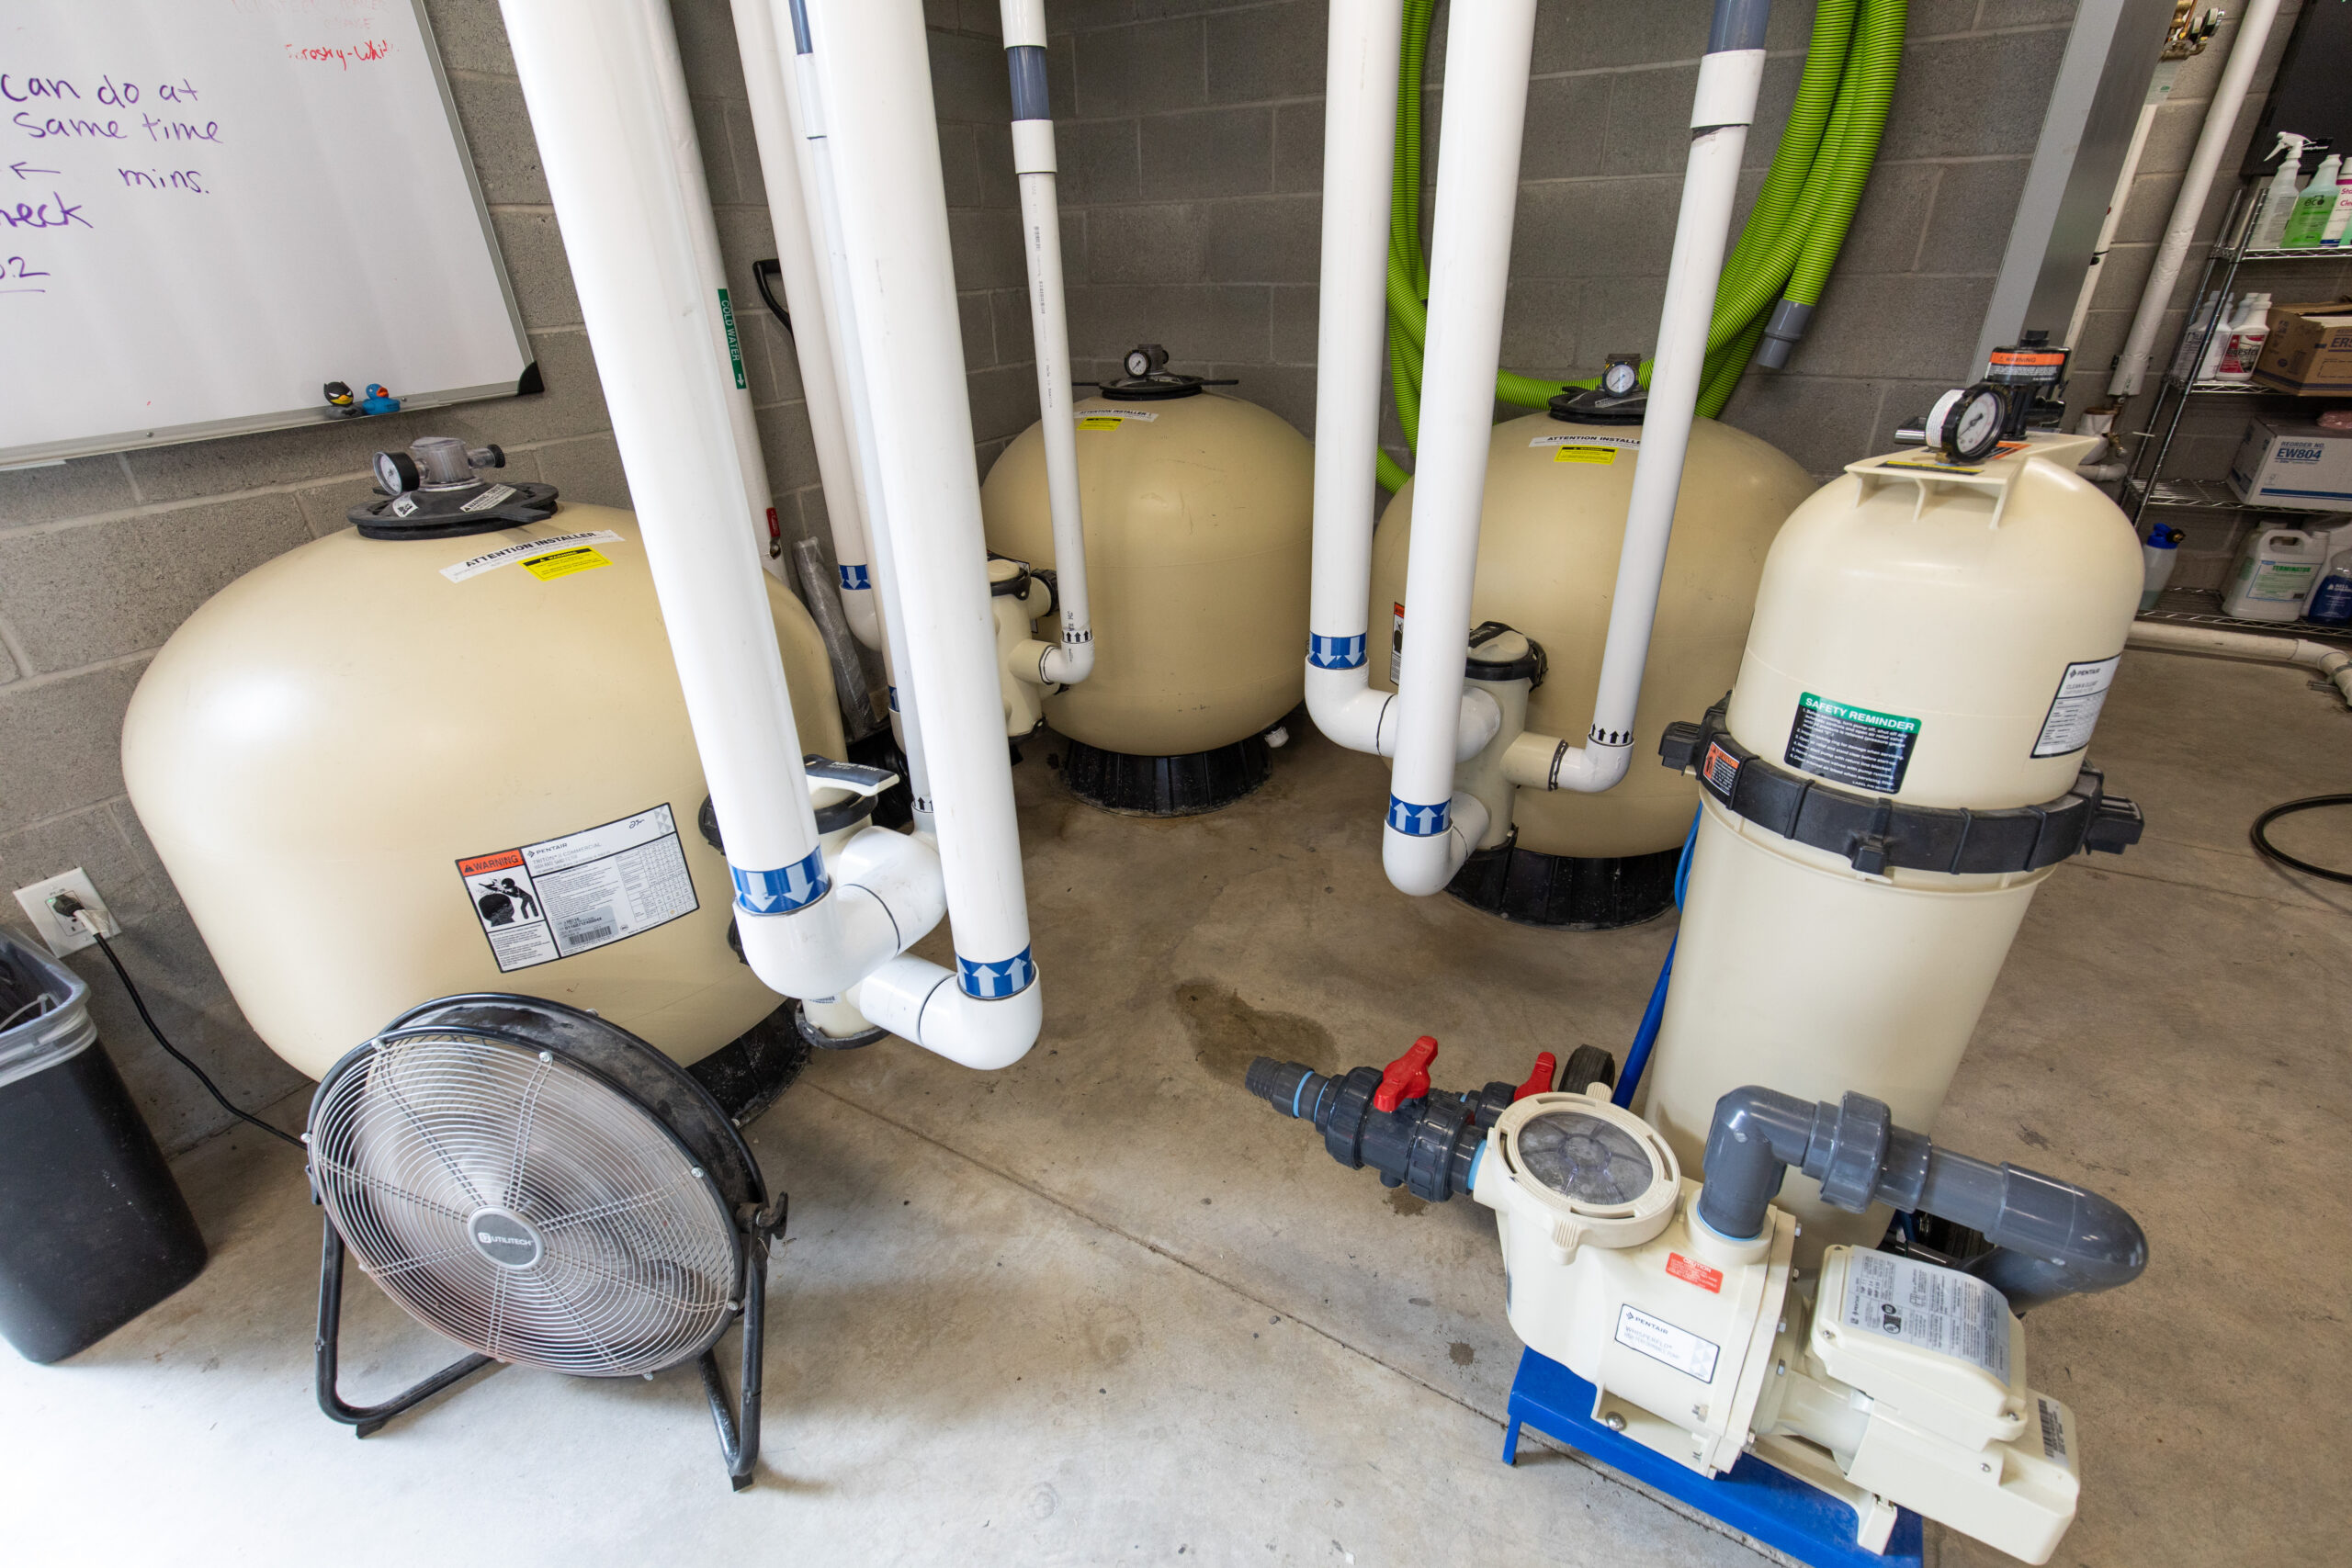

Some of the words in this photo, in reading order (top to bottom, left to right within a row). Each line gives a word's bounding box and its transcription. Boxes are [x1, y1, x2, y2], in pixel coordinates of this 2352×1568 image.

[97, 74, 139, 108] do
[159, 78, 198, 103] at
[142, 112, 224, 143] time
[118, 168, 209, 194] mins.
[720, 299, 732, 326] COLD
[728, 328, 740, 362] WATER
[2277, 447, 2323, 459] EW804
[465, 542, 534, 568] ATTENTION
[534, 531, 597, 547] INSTALLER
[2077, 668, 2100, 676] PENTAIR
[1805, 697, 1848, 717] SAFETY
[1849, 711, 1916, 731] REMINDER
[536, 842, 568, 855] PENTAIR
[472, 854, 519, 872] WARNING
[1683, 1258, 1712, 1273] CAUTION
[1635, 1316, 1668, 1335] PENTAIR
